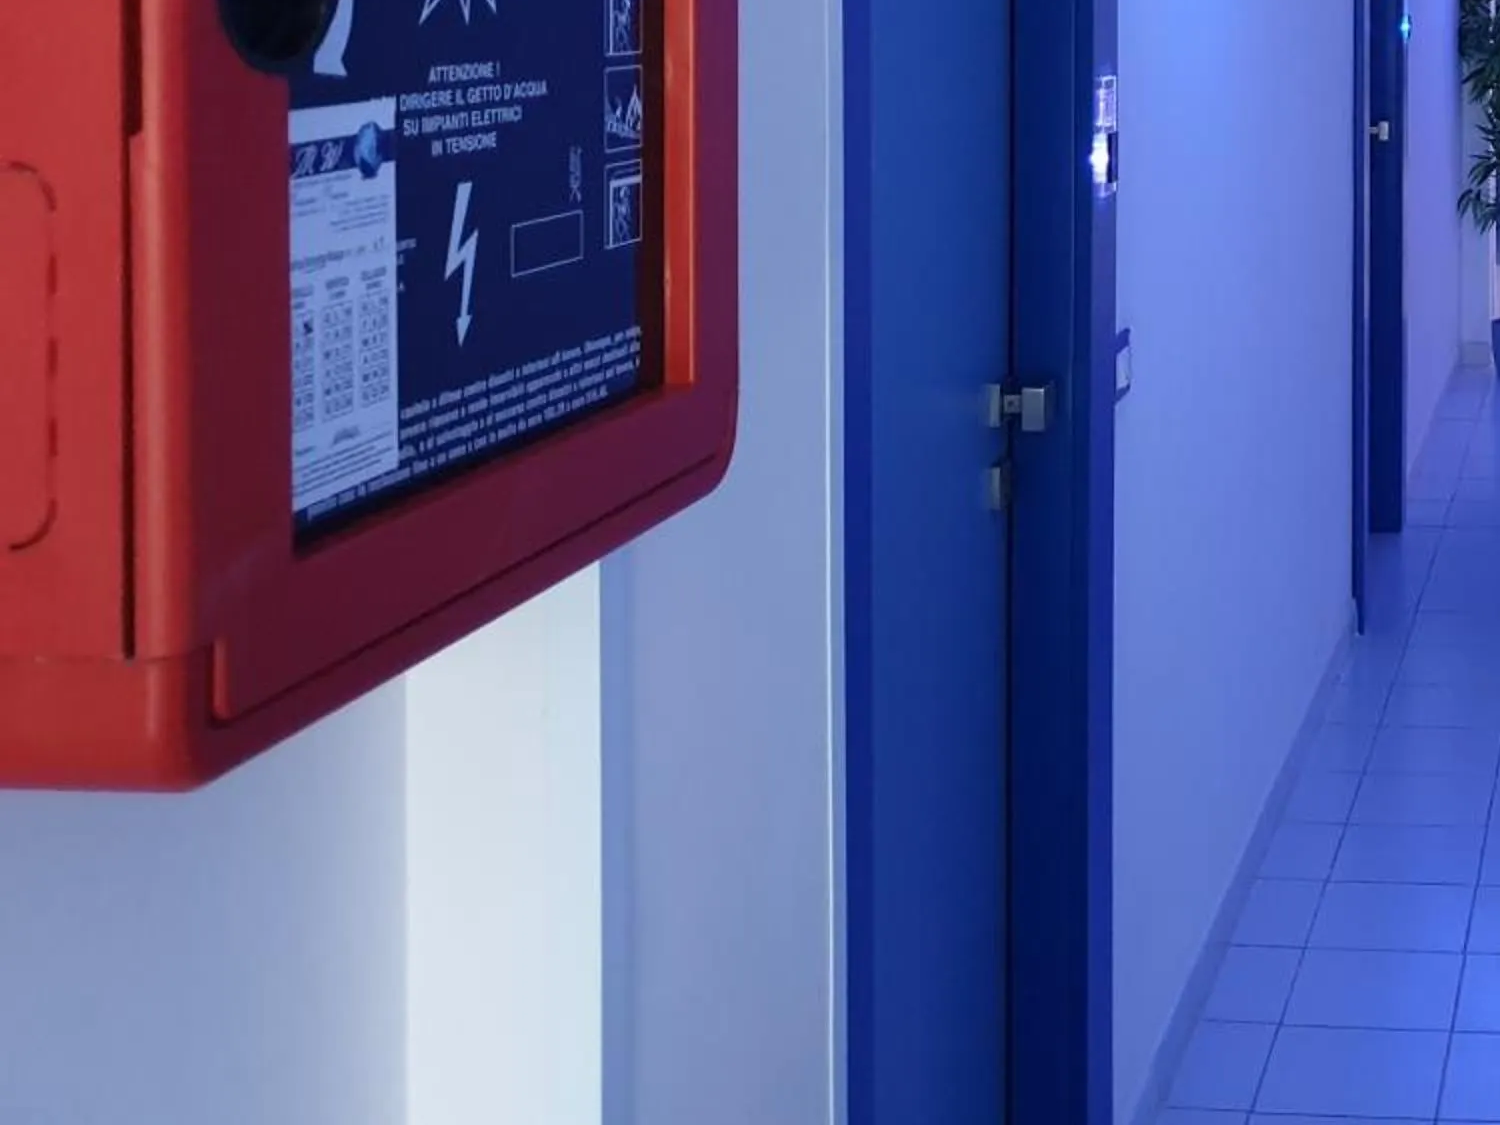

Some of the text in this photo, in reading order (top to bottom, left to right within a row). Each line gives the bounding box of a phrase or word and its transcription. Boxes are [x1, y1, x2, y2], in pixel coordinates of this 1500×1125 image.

[428, 61, 494, 83] ATTENZIONE
[400, 90, 453, 111] DIRIGERE
[467, 84, 501, 104] GETTO
[403, 117, 419, 136] SU
[445, 130, 497, 154] TENSIONE
